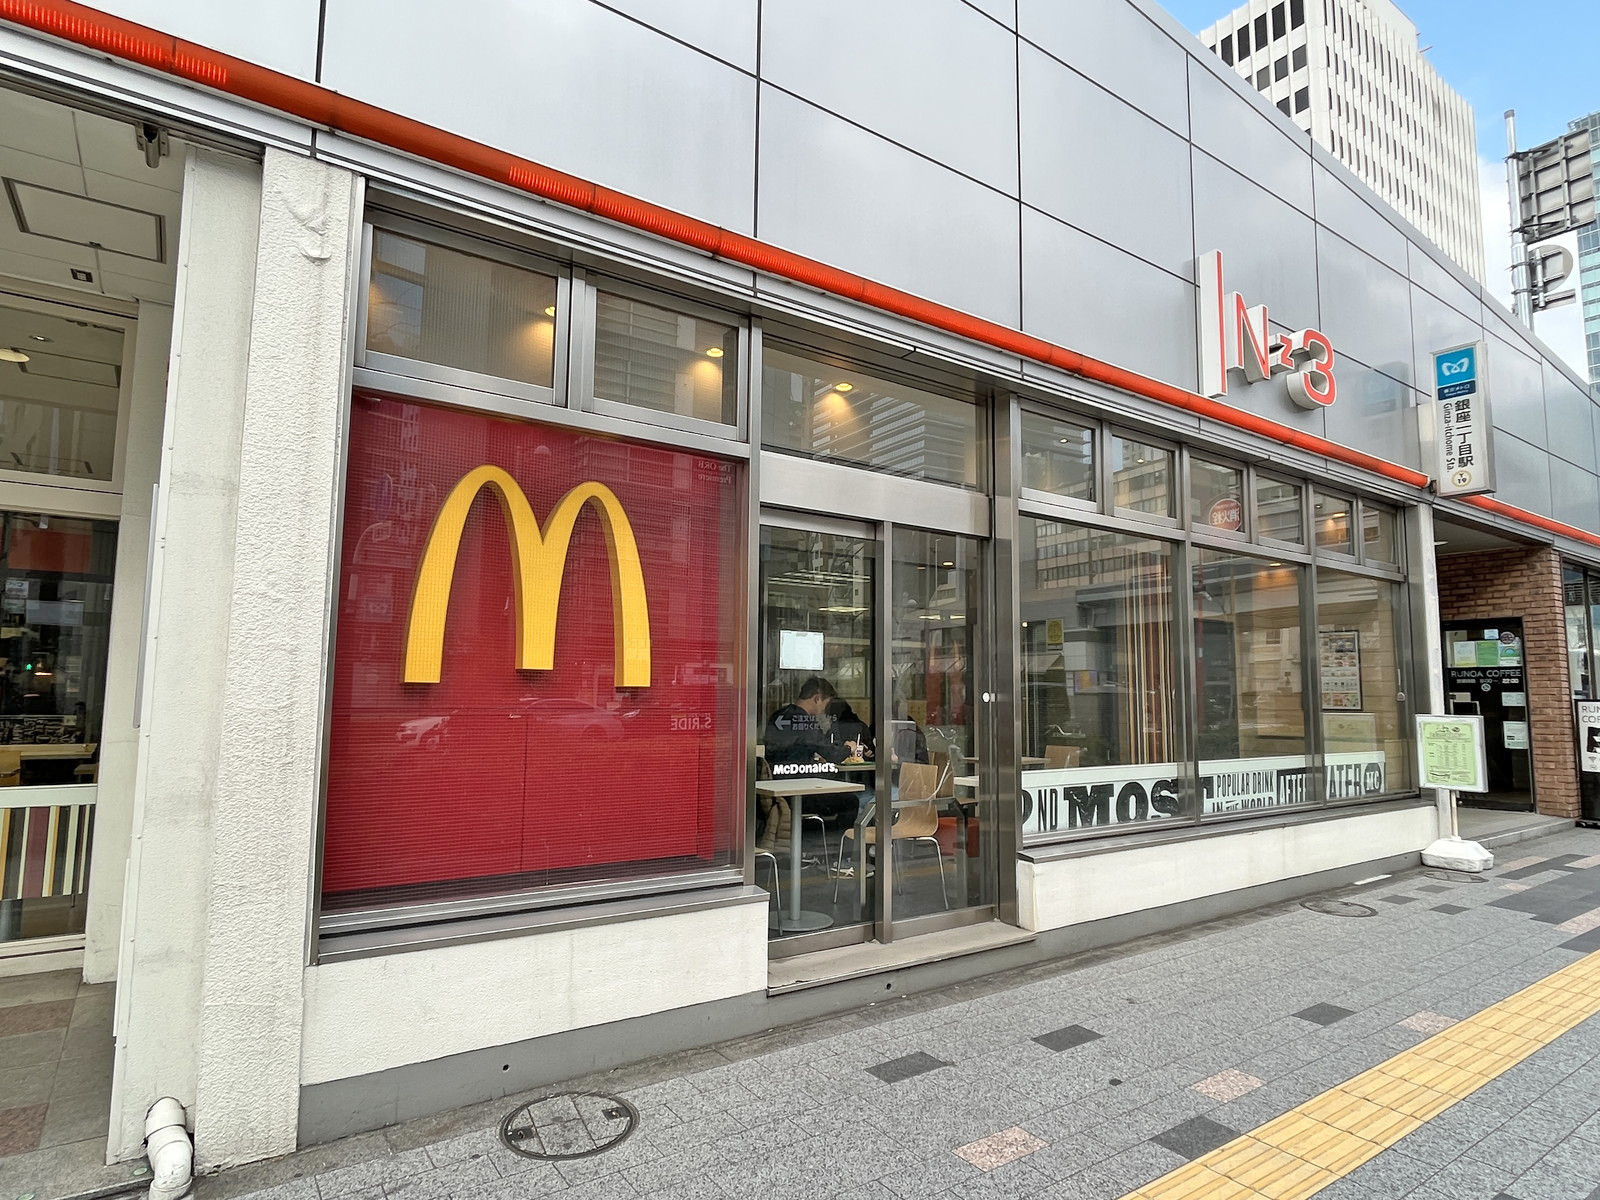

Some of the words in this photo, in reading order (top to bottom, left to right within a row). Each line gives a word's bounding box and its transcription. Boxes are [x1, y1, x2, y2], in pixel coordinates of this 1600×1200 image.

[1443, 402, 1455, 457] Ginza-itchome
[1454, 398, 1474, 468] 銀座一丁目駅
[1486, 669, 1522, 678] COFFEE
[1216, 772, 1250, 798] POPULAR
[1252, 770, 1274, 795] DRINK
